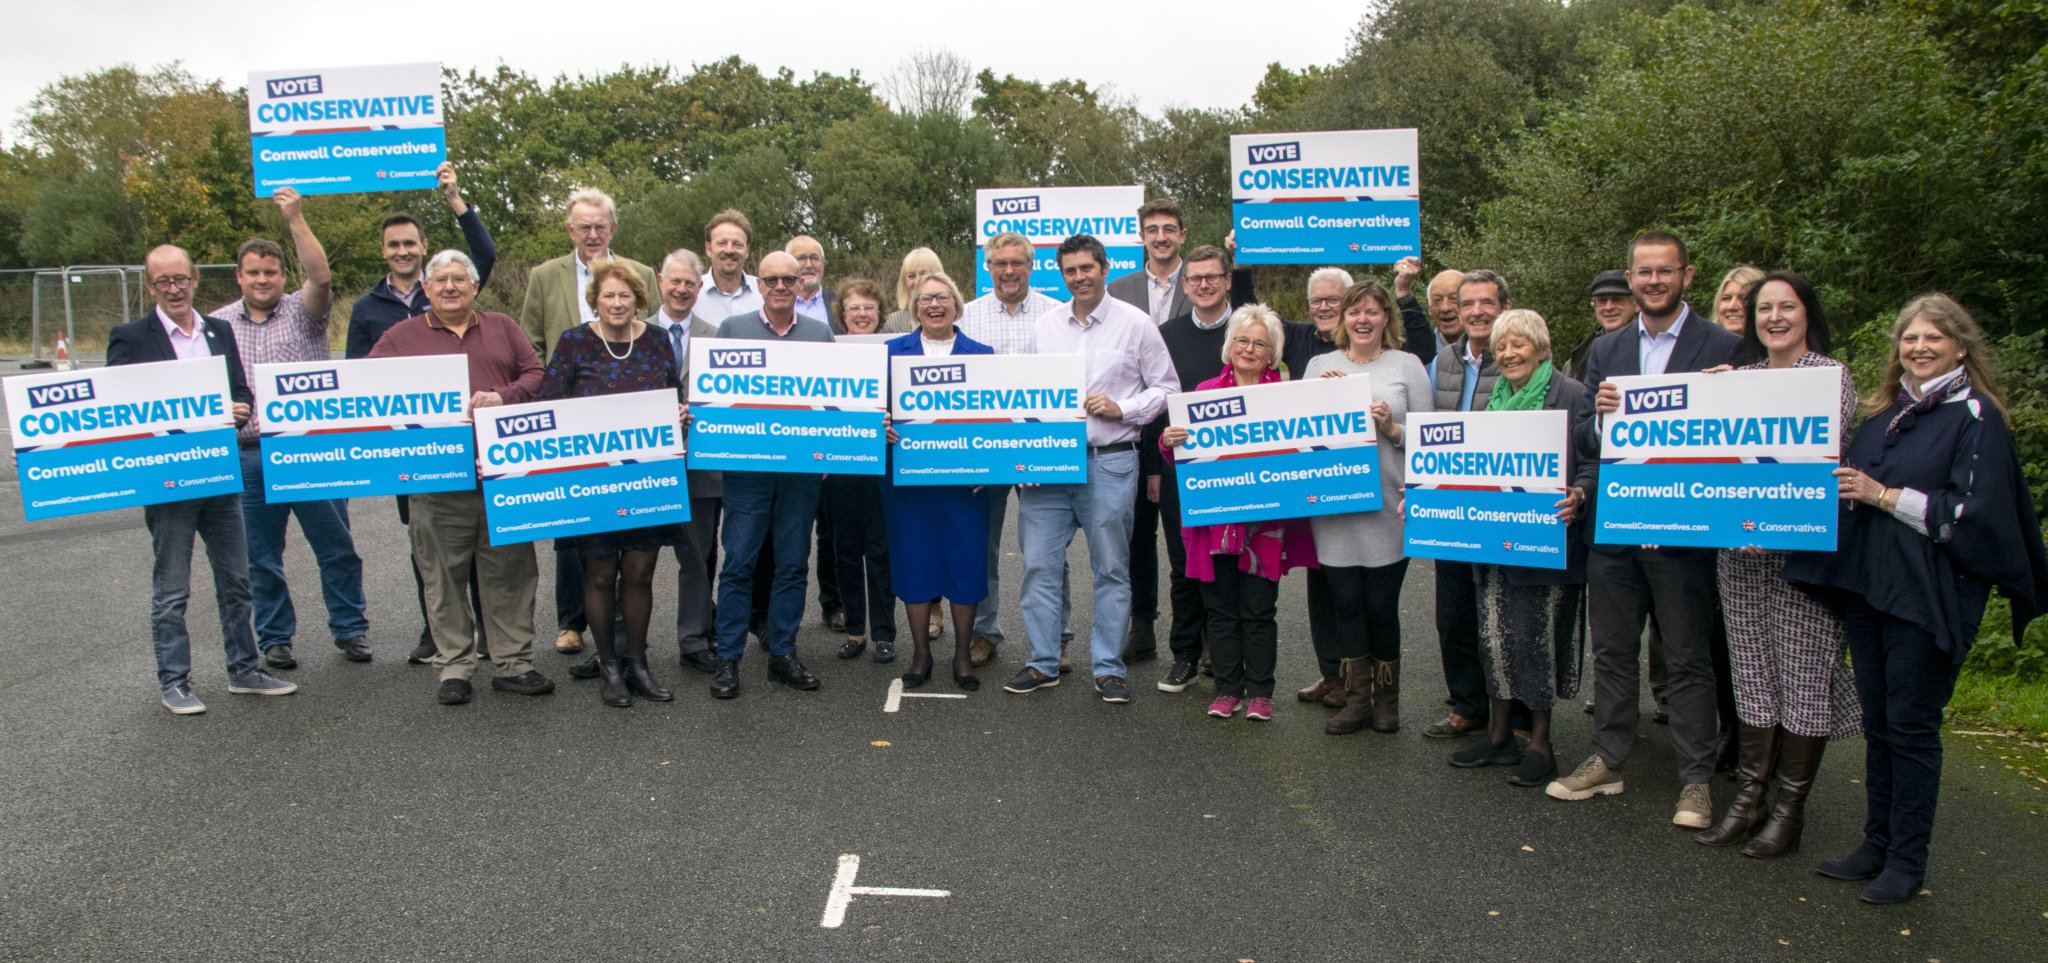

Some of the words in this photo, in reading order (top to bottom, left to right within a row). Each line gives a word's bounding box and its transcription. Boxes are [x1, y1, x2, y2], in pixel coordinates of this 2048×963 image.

[270, 78, 319, 95] VOTE
[258, 95, 435, 123] CONSERVATIVE
[260, 147, 329, 162] Cornwall
[332, 142, 436, 158] Conservatives
[1252, 145, 1297, 161] VOTE
[390, 169, 436, 178] Conservative
[1239, 166, 1410, 190] CONSERVATIVE
[996, 198, 1037, 212] VOTE
[983, 217, 1136, 237] CONSERVATIVE
[1241, 217, 1304, 229] Cornwall
[1308, 215, 1410, 228] Conservatives
[1362, 243, 1412, 251] Conservatives
[713, 352, 762, 366] VOTE
[280, 373, 334, 392] VOTE
[914, 367, 962, 382] VOTE
[32, 382, 90, 404] VOTE
[697, 373, 879, 398] CONSERVATIVE
[266, 392, 462, 422] CONSERVATIVE
[900, 389, 1077, 411] CONSERVATIVE
[1629, 389, 1683, 410] VOTE
[20, 394, 223, 437] CONSERVATIVE
[1192, 399, 1242, 420] VOTE
[500, 413, 551, 434] VOTE
[696, 421, 766, 435] Cornwall
[770, 423, 877, 438] Conservatives
[1183, 412, 1366, 450] CONSERVATIVE
[1611, 416, 1829, 447] CONSERVATIVE
[1423, 425, 1461, 442] VOTE
[487, 425, 674, 465] CONSERVATIVE
[901, 437, 968, 449] Cornwall
[972, 436, 1077, 449] Conservatives
[271, 449, 346, 464] Cornwall
[350, 442, 464, 460] Conservatives
[695, 452, 786, 460] CornwallConservatives.com
[826, 453, 878, 461] Conservatives
[28, 459, 108, 480] Cornwall
[112, 445, 229, 470] Conservatives
[1028, 464, 1079, 472] Conservatives
[1411, 452, 1558, 477] CONSERVATIVE
[179, 474, 234, 487] Conservatives
[272, 479, 370, 491] CornwallConservatives.com
[413, 472, 467, 481] Conservatives
[1186, 472, 1255, 490] Cornwall
[1260, 463, 1370, 483] Conservatives
[32, 489, 135, 508] CornwallConservatives.com
[494, 488, 566, 507] Cornwall
[570, 476, 678, 498] Conservatives
[1321, 492, 1374, 503] Conservatives
[1607, 482, 1685, 498] Cornwall
[1690, 483, 1826, 499] Conservatives
[631, 503, 682, 515] Conservatives
[1188, 502, 1279, 515] CornwallConservatives.com
[1411, 504, 1464, 520] Cornwall
[1468, 507, 1557, 524] Conservatives
[496, 516, 590, 532] CornwallConservatives.com
[1604, 521, 1709, 531] CornwallConservatives.com
[1759, 522, 1827, 532] Conservatives
[1409, 538, 1481, 548] CornwallConservatives.com
[1514, 543, 1558, 553] Conservatives
